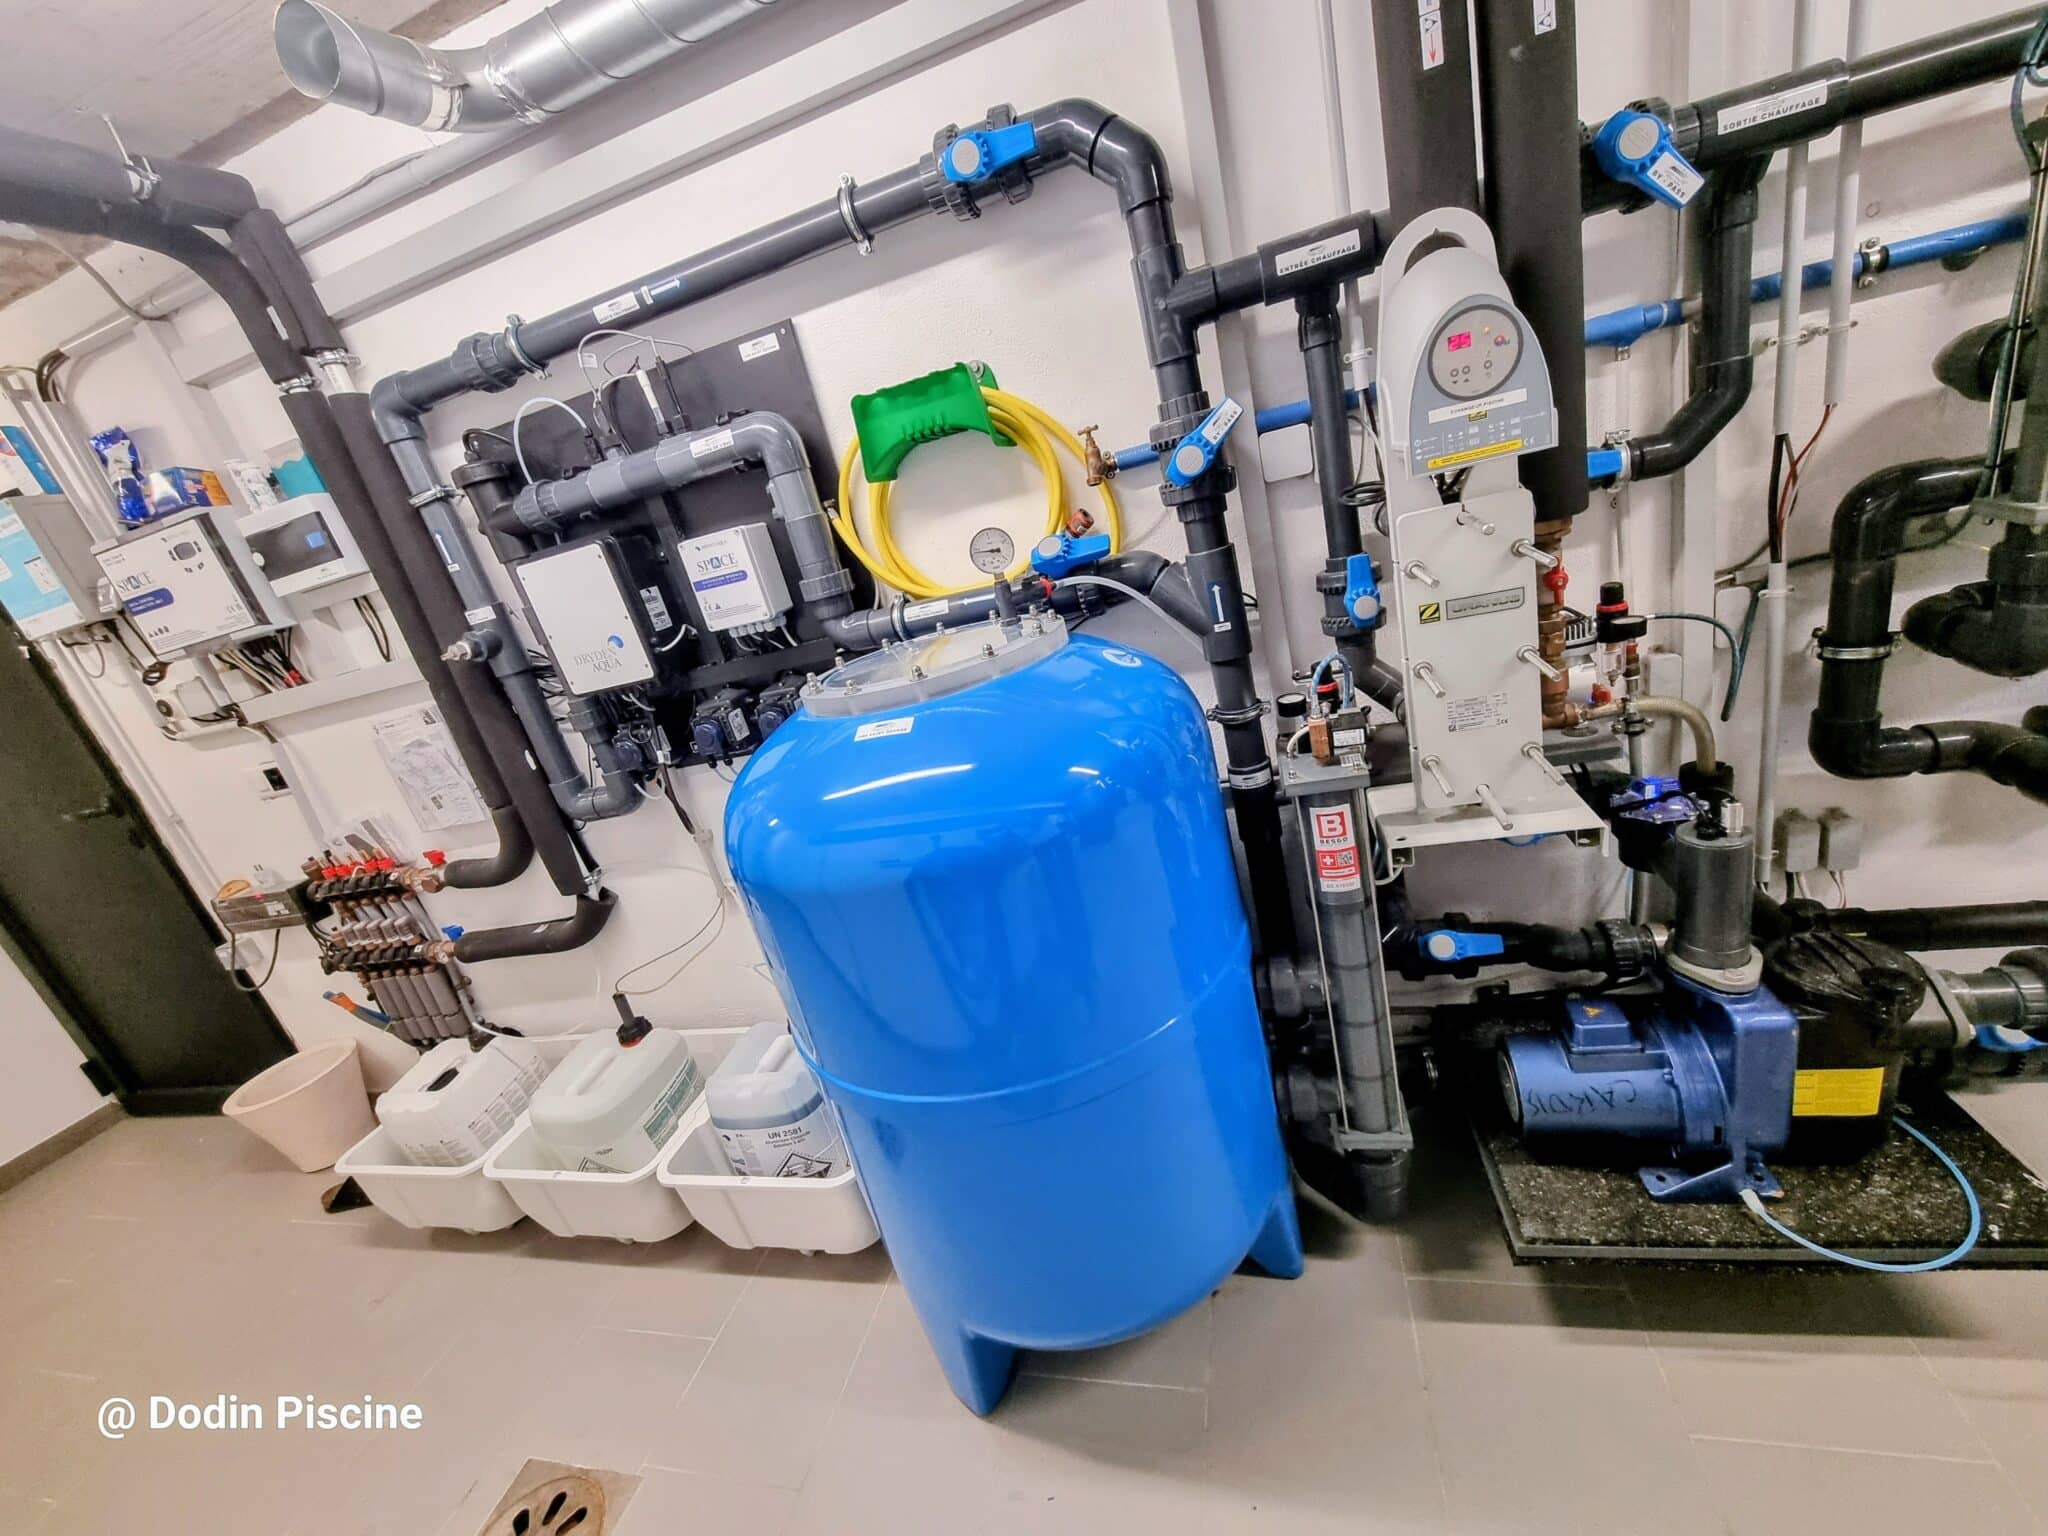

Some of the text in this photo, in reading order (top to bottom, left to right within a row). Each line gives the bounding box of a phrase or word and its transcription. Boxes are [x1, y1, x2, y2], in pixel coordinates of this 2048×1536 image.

[1723, 97, 1820, 131] SORTIE CHAUFFAGE
[1667, 181, 1685, 198] PASS
[1311, 244, 1356, 264] CHAUFFAGE
[697, 552, 738, 573] SPACE
[593, 657, 622, 672] AQUA
[1319, 837, 1348, 845] BESGO
[767, 1131, 781, 1141] UN
